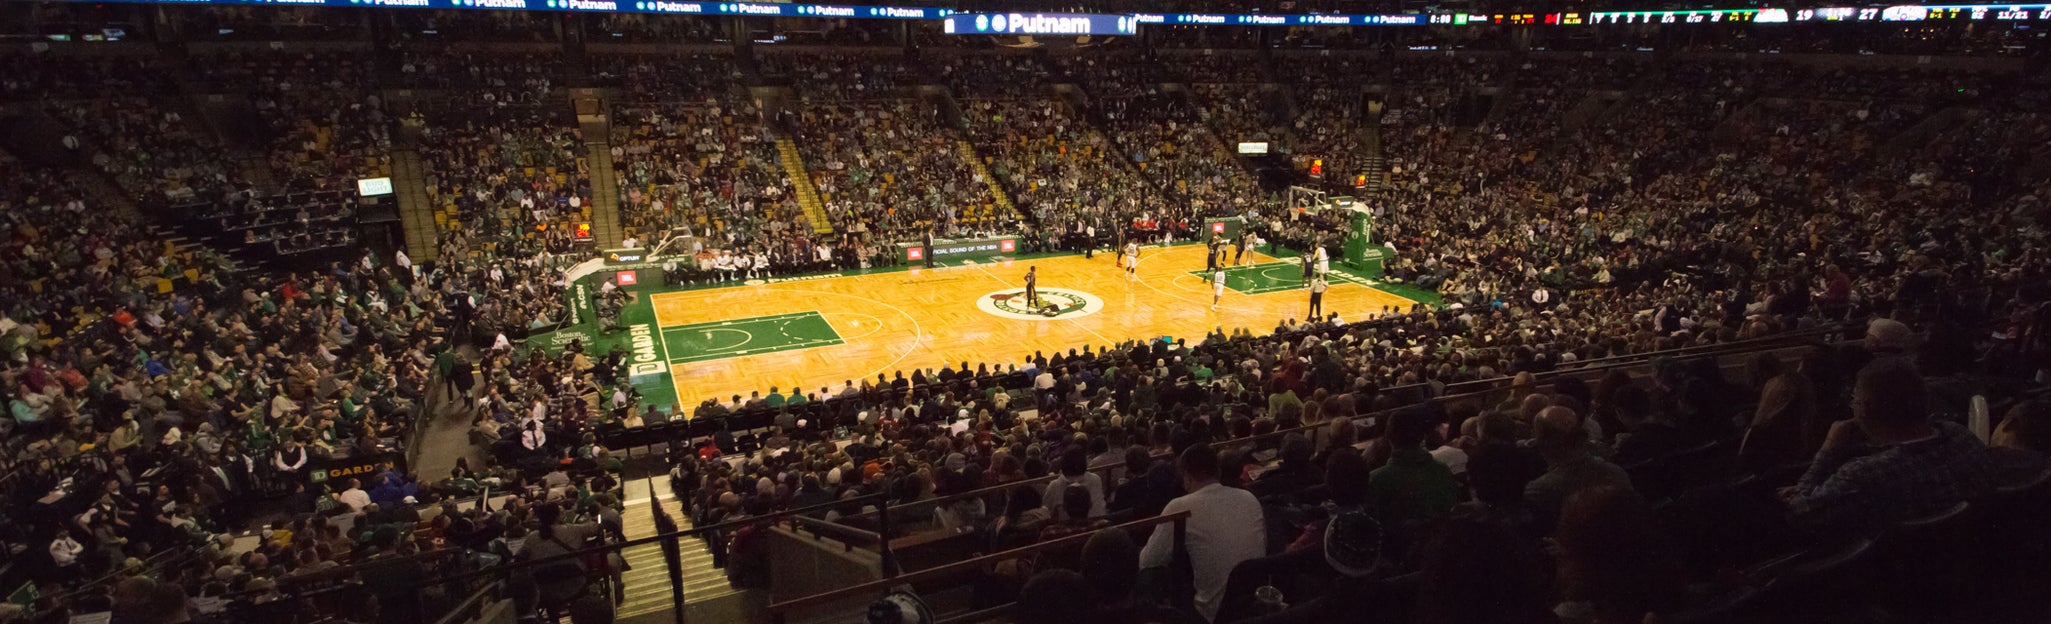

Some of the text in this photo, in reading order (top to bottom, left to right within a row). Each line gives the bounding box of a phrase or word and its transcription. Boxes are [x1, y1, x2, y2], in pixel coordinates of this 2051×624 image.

[569, 0, 617, 10] Putnam
[657, 1, 702, 12] Putnam
[738, 4, 781, 14] Putnam
[815, 6, 855, 16] Putnam
[887, 7, 924, 17] Putnam
[1796, 9, 1814, 21] 19
[1858, 8, 1879, 20] 27
[1997, 11, 2029, 20] 11/21
[1009, 13, 1091, 33] Putnam
[1135, 14, 1164, 23] Putnam
[1192, 15, 1225, 23] Putnam
[1252, 15, 1286, 24] Putnam
[1315, 15, 1350, 24] Putnam
[1380, 15, 1416, 24] Putnam
[629, 323, 657, 362] GARDEN
[312, 461, 395, 480] TD GARDN
